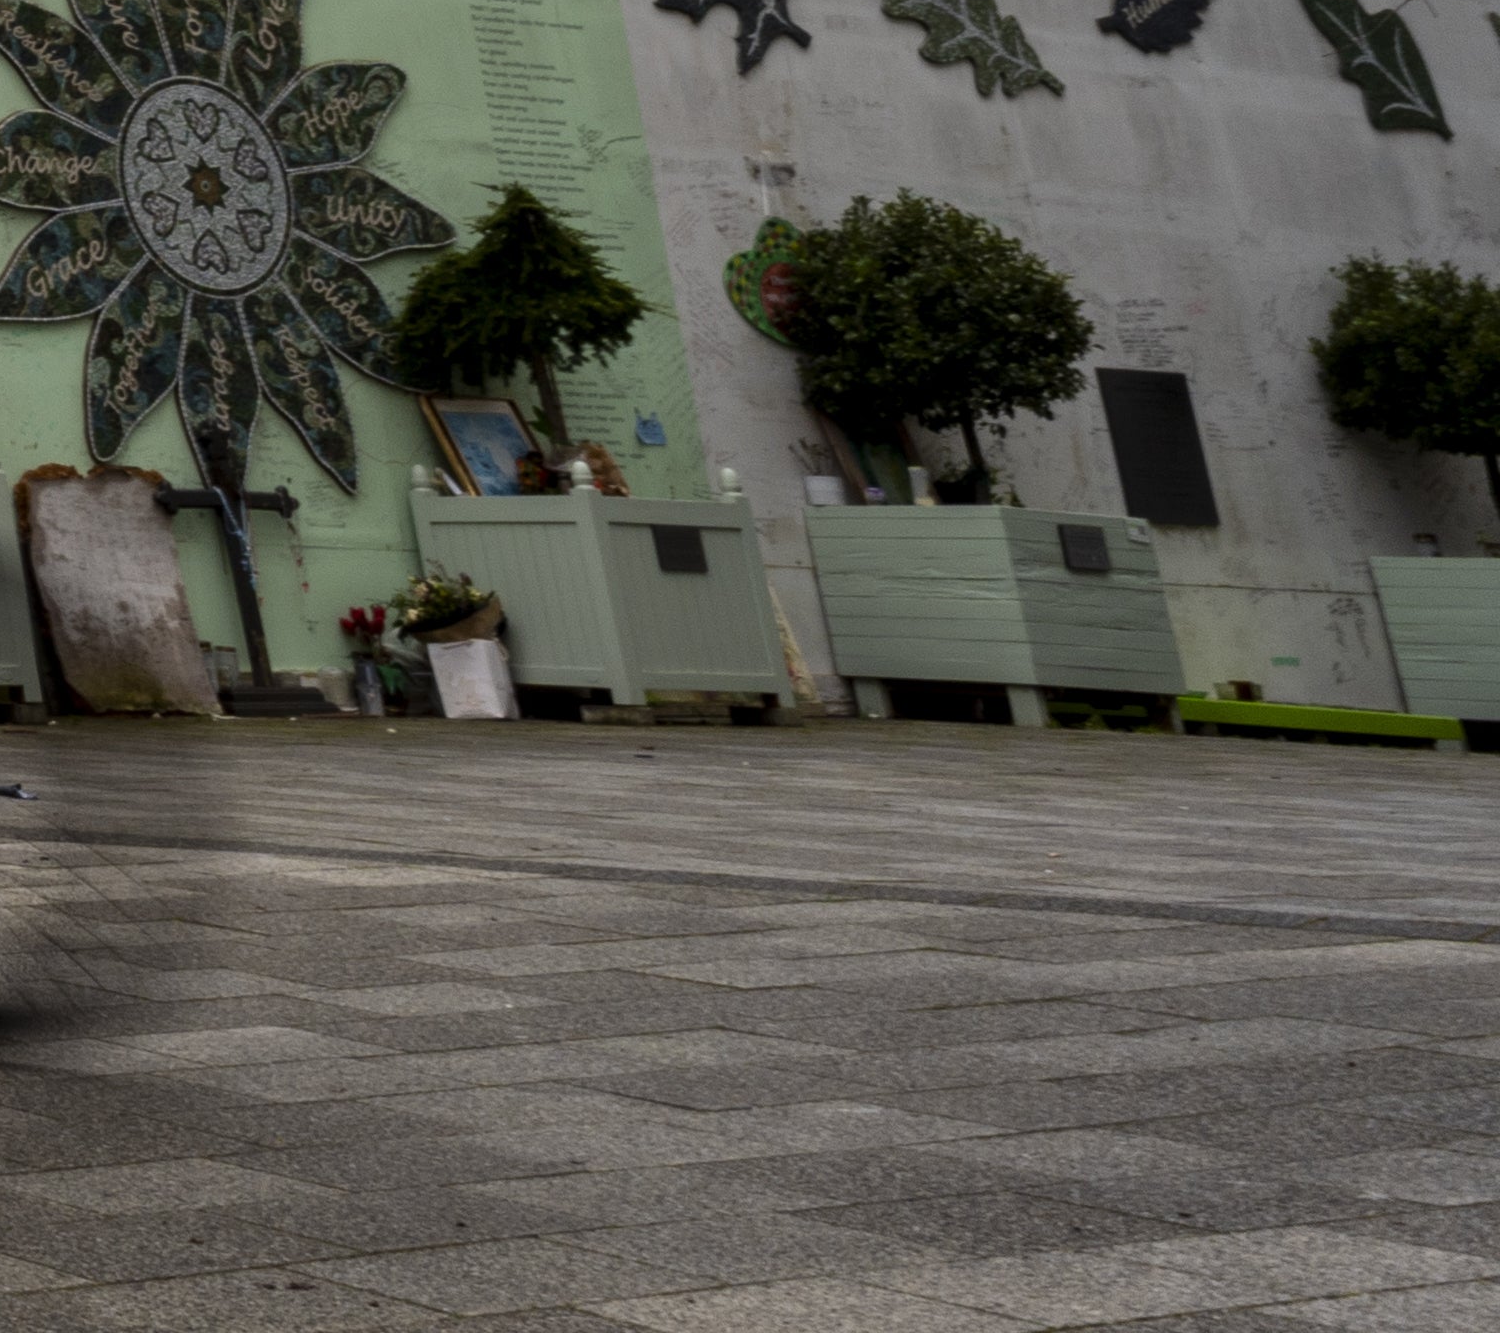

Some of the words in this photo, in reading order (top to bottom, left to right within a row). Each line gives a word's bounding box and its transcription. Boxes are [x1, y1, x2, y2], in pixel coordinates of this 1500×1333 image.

[0, 9, 105, 103] Resilience
[300, 90, 364, 138] Hope
[325, 195, 408, 238] Unity
[26, 239, 107, 300] Grace
[103, 303, 158, 415] Together
[274, 324, 337, 430] Respect
